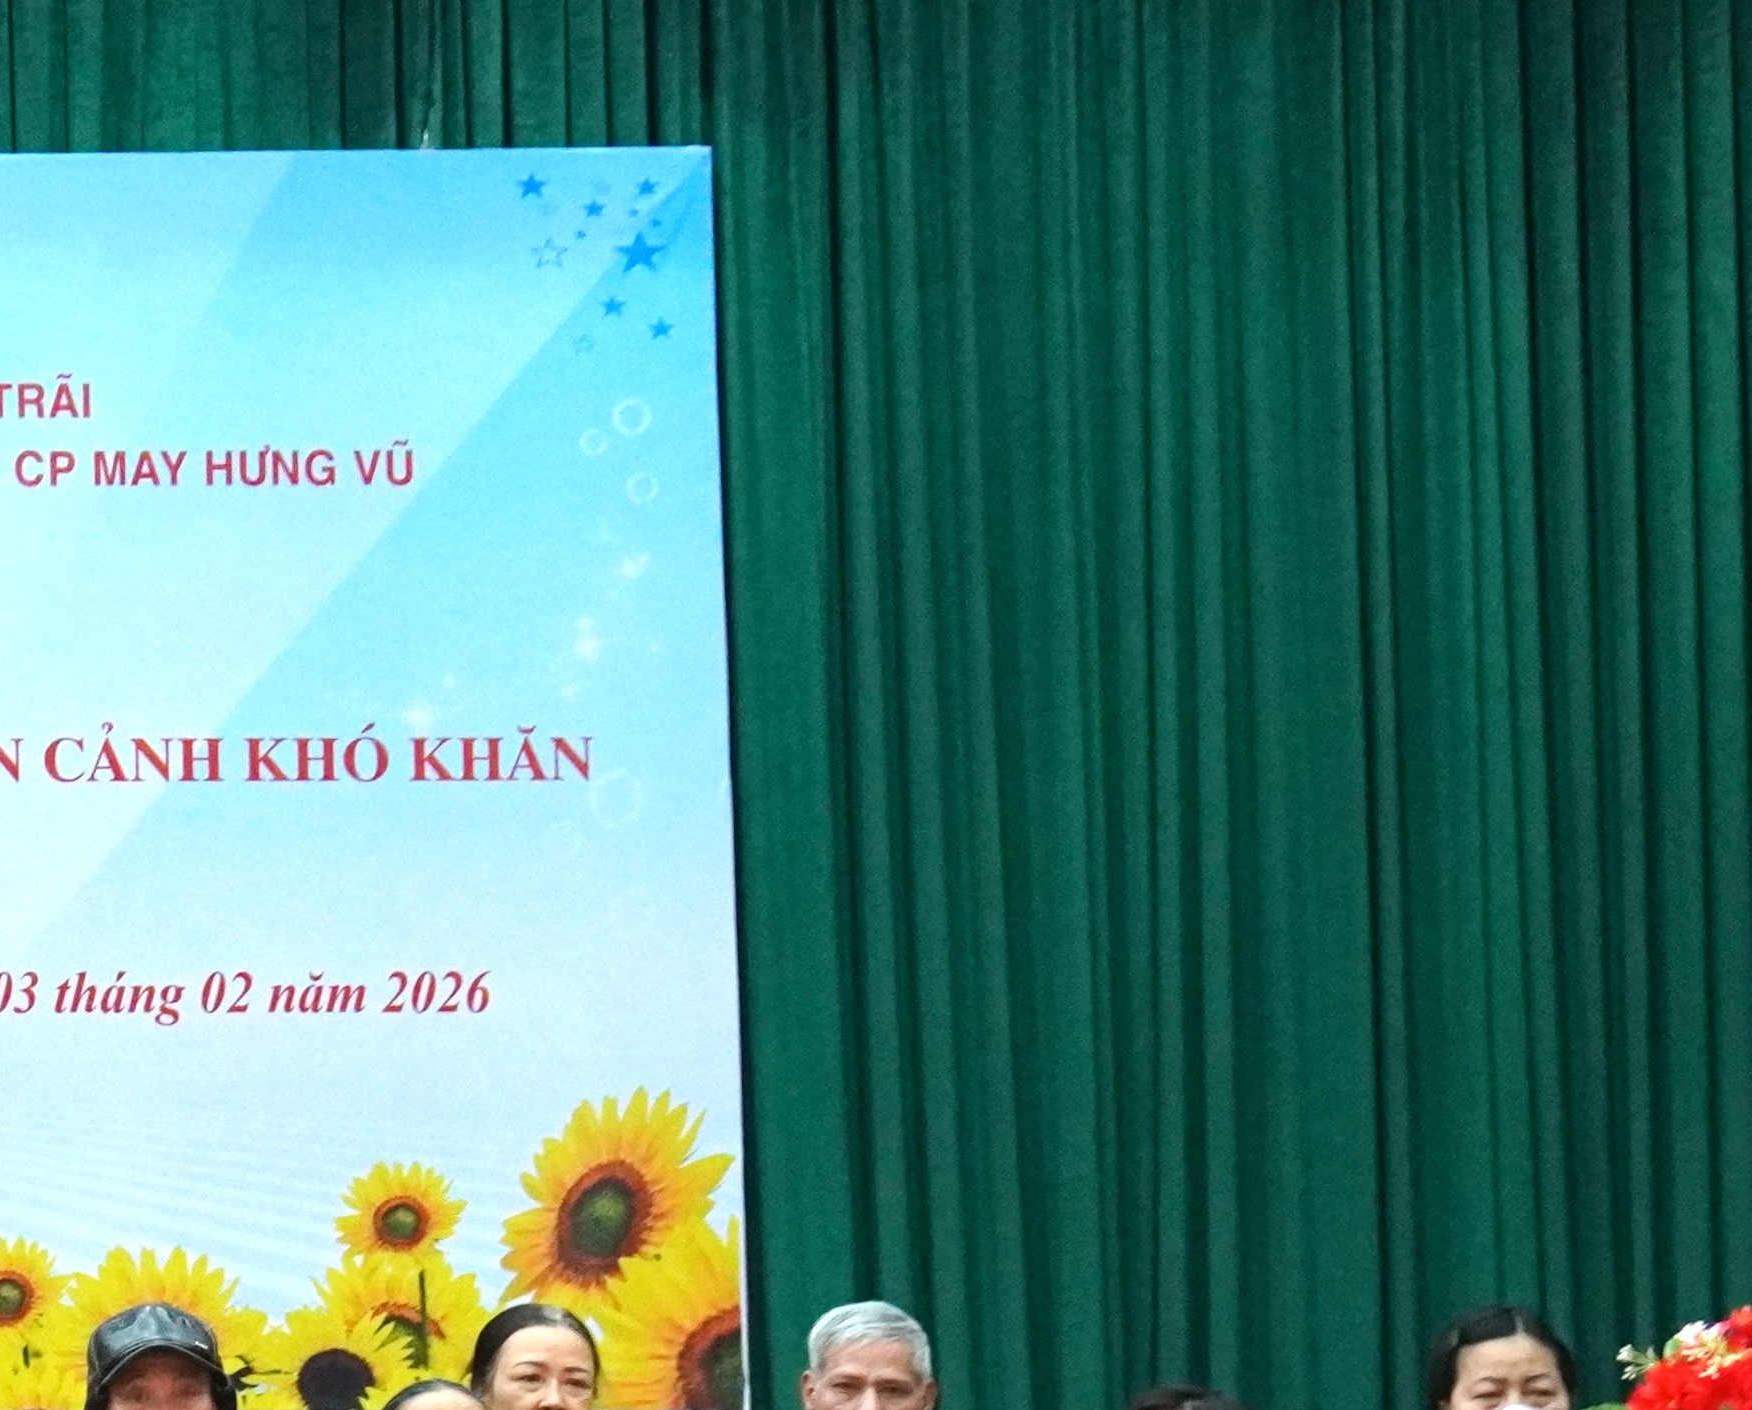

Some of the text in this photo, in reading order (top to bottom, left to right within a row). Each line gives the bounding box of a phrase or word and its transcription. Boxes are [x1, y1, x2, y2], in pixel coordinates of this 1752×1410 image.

[14, 449, 76, 488] CP
[93, 449, 188, 488] MAY
[205, 444, 337, 488] HƯNG
[352, 438, 414, 487] VŨ
[43, 721, 226, 784] CẢNH
[243, 721, 390, 783] KHÓ
[408, 725, 593, 782] KHĂN
[53, 970, 186, 1027] tháng
[200, 970, 254, 1015] 02
[267, 971, 367, 1015] năm
[381, 970, 491, 1015] 2026
